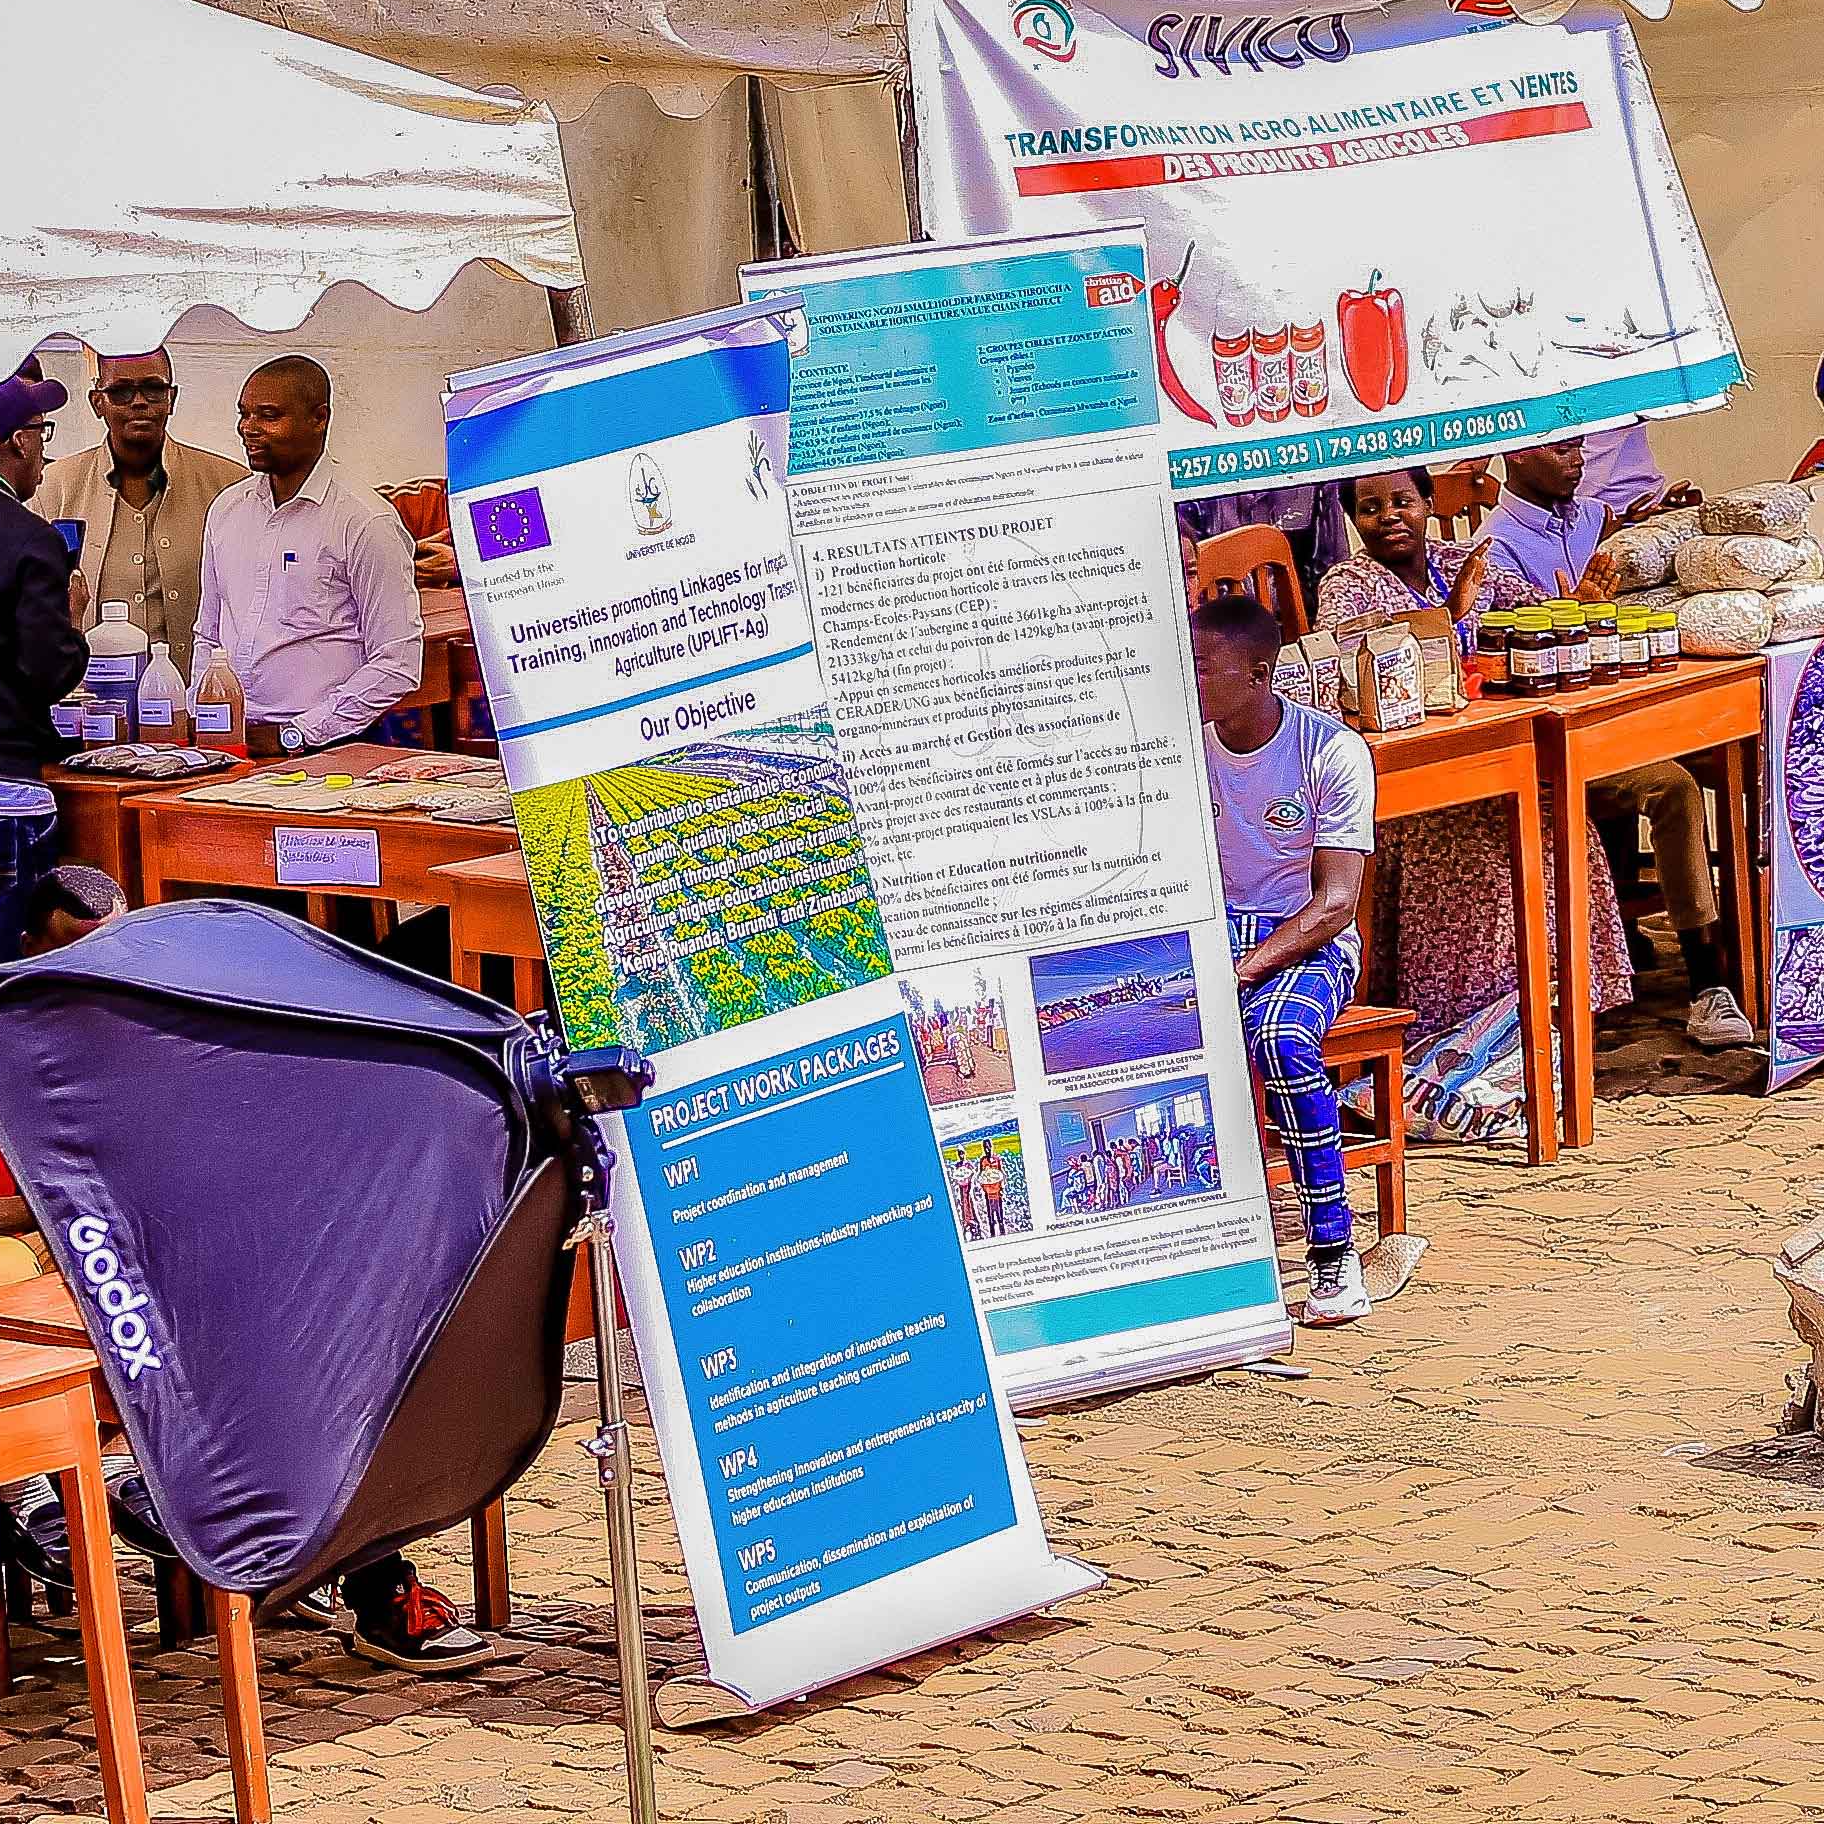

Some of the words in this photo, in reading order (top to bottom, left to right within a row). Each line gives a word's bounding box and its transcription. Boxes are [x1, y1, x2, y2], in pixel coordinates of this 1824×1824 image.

[1146, 13, 1354, 79] SIVICO
[1003, 123, 1234, 158] TRANSFORMATION
[1240, 91, 1468, 143] AGRO-ALIMENTAIRE
[1470, 82, 1502, 107] ET
[1510, 70, 1579, 100] VENTES
[1163, 154, 1213, 181] DES
[1214, 147, 1329, 177] PRODUITS
[1330, 125, 1471, 167] AGRICOLES
[1098, 276, 1136, 306] aid
[1169, 454, 1211, 480] +257
[1216, 449, 1238, 474] 69
[1243, 446, 1272, 471] 501
[1277, 441, 1310, 467] 325
[1328, 434, 1352, 460] 79
[1356, 429, 1389, 455] 438
[1391, 424, 1423, 451] 349
[1443, 417, 1464, 442] 69
[1466, 413, 1495, 437] 086
[1497, 408, 1527, 433] 031
[826, 537, 907, 563] RESULTATS
[909, 528, 976, 552] ATTEINTS
[978, 524, 1000, 540] DU
[1002, 516, 1055, 537] PROJET
[506, 635, 587, 675] Training,
[588, 620, 660, 655] innovation
[662, 610, 688, 634] and
[687, 588, 767, 632] Technology
[510, 604, 609, 645] Universities
[610, 586, 678, 624] promoting
[679, 567, 742, 601] Linkages
[743, 558, 763, 579] for
[614, 640, 687, 678] Agriculture
[687, 613, 770, 659] (UPLIFT-Ag)
[640, 712, 673, 742] Our
[675, 690, 757, 733] Objective
[598, 825, 619, 844] To
[621, 804, 686, 840] contribute
[685, 798, 704, 817] to
[704, 778, 781, 814] sustainable
[633, 844, 682, 873] growth,
[682, 829, 727, 857] quality
[727, 818, 760, 844] jobs
[761, 808, 787, 829] and
[787, 795, 827, 823] social
[593, 876, 683, 916] development
[682, 857, 738, 888] through
[737, 837, 806, 871] innovative
[602, 907, 678, 948] Agriculture
[677, 893, 723, 923] higher
[724, 875, 791, 910] education
[790, 854, 858, 889] institutions
[621, 947, 668, 975] Kenya,
[668, 926, 726, 962] Rwanda,
[726, 907, 779, 940] Burundi
[781, 900, 807, 923] and
[806, 883, 870, 916] Zimbabwe
[650, 1085, 731, 1137] PROJECT
[733, 1062, 803, 1107] WORK
[799, 1029, 901, 1082] PACKAGES
[662, 1156, 699, 1189] WP1
[679, 1239, 717, 1272] WP2
[68, 1214, 163, 1380] Godox
[699, 1347, 737, 1380] WP3
[718, 1445, 759, 1480] WP4
[737, 1538, 776, 1572] WP5
